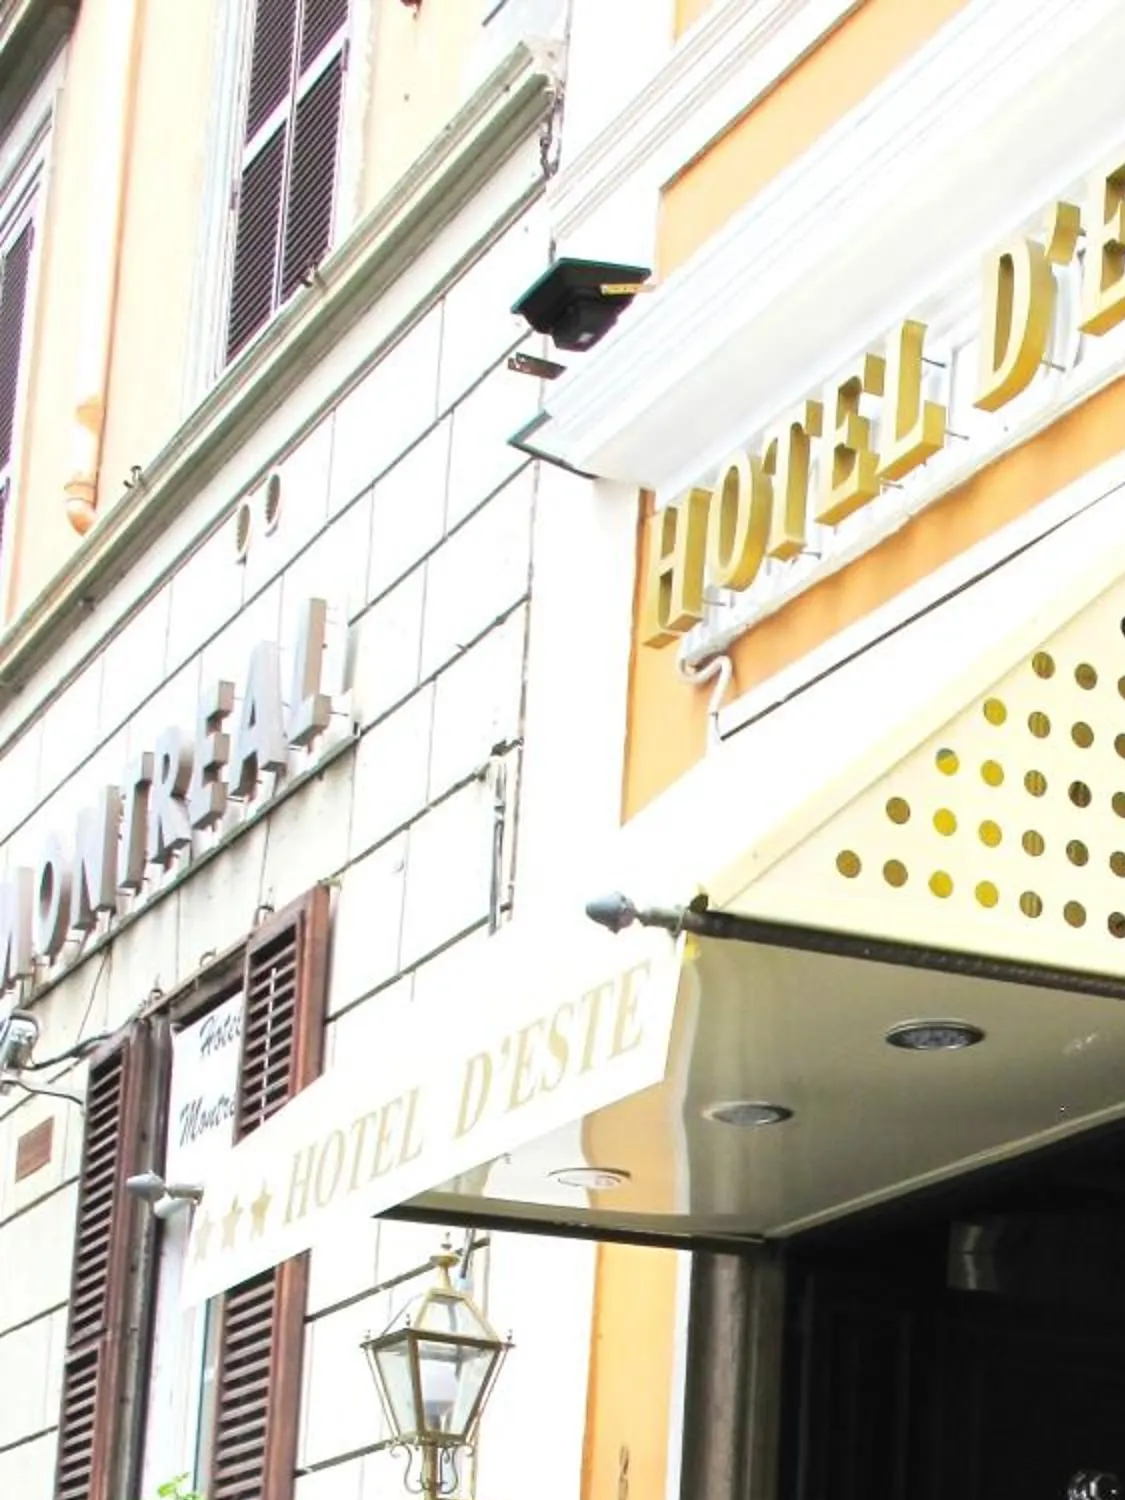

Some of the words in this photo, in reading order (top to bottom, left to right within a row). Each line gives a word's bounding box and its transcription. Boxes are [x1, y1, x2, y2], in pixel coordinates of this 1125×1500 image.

[643, 320, 947, 649] HOTEL
[282, 1086, 425, 1227] HOTEL
[453, 959, 653, 1140] D'ESTE
